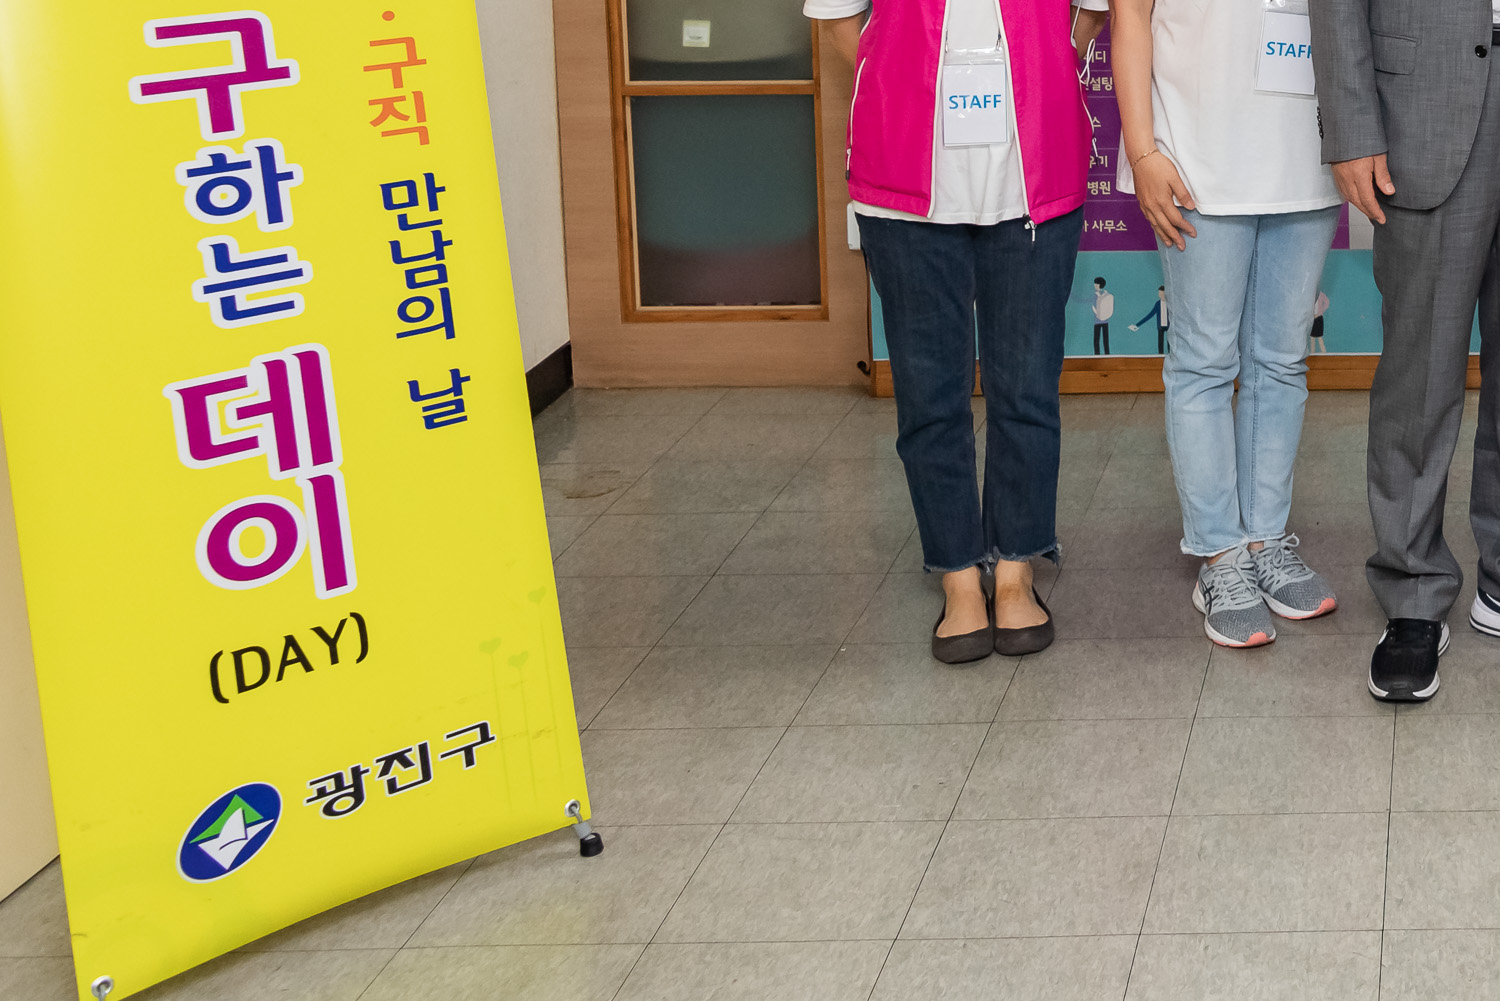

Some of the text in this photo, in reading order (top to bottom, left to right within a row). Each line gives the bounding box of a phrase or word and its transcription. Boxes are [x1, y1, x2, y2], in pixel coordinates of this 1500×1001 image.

[949, 94, 1002, 110] STAFF
[1085, 76, 1113, 91] 설팅
[140, 17, 304, 321] 구하는
[379, 172, 457, 340] 만남의
[1092, 220, 1128, 233] 사무소
[407, 368, 471, 431] 날
[174, 349, 348, 591] 데이
[209, 611, 369, 704] (DAY)
[304, 720, 497, 818] 광진구
